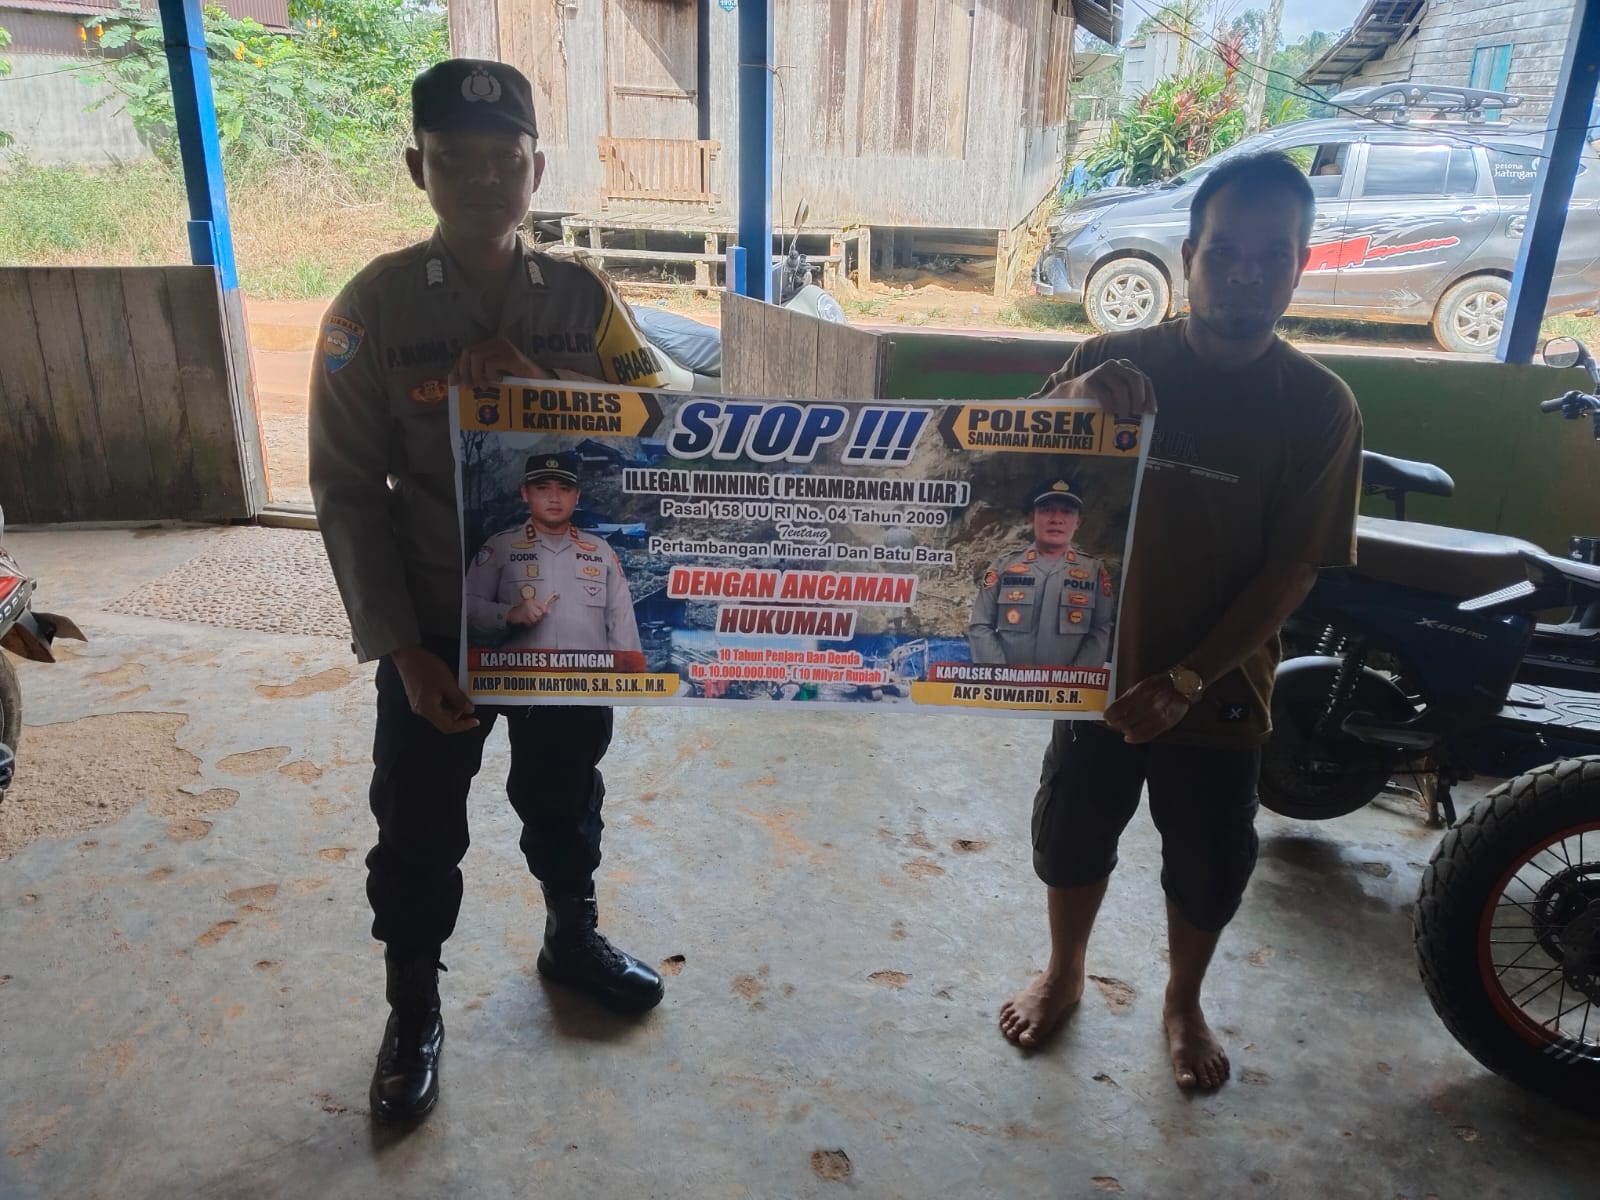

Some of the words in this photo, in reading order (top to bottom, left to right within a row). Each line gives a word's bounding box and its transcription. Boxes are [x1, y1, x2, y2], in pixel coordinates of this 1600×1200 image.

[1494, 162, 1524, 170] pesona
[532, 333, 592, 354] POLRI
[522, 388, 621, 414] POLRES
[522, 413, 622, 432] KATINGAN
[671, 401, 846, 458] STOP
[847, 408, 929, 461] !!!
[967, 408, 1096, 436] POLSEK
[967, 433, 1030, 449] SANAMAN
[1031, 434, 1093, 450] MANTIKEI
[625, 471, 689, 493] ILLEGAL
[692, 472, 770, 496] MINNING
[773, 477, 780, 497] (
[785, 477, 915, 502] PENAMBANGAN
[918, 482, 957, 505] LIAR
[961, 485, 968, 505] )
[663, 502, 708, 517] Pasal
[712, 504, 740, 518] 158
[745, 505, 769, 519] UU
[775, 506, 792, 520] RI
[796, 507, 823, 521] No.
[828, 508, 847, 522] 04
[852, 509, 901, 523] Tahun
[906, 510, 945, 525] 2009
[778, 524, 829, 542] Tentang
[510, 553, 538, 562] DODIK
[651, 539, 768, 558] Pertambangan
[773, 542, 833, 559] Mineral
[837, 545, 868, 559] Dan
[873, 546, 912, 561] Batu
[916, 548, 953, 562] Bara
[670, 569, 778, 599] DENGAN
[780, 573, 915, 603] ANCAMAN
[1063, 579, 1095, 591] POLRI
[719, 608, 853, 637] HUKUMAN
[480, 652, 547, 668] KAPOLRES
[550, 652, 614, 668] KATINGAN
[719, 648, 731, 662] 10
[733, 649, 763, 663] Tahun
[765, 650, 804, 666] Penjara
[806, 651, 826, 665] Dan
[827, 652, 860, 666] Denda
[691, 665, 706, 679] Rp.
[800, 667, 811, 681] 10
[812, 668, 843, 683] Milyar
[845, 669, 881, 684] Rupiah
[936, 666, 993, 681] KAPOLSEK
[994, 668, 1049, 683] SANAMAN
[1051, 671, 1106, 686] MANTIKEI
[472, 676, 502, 691] AKBP
[503, 677, 536, 692] DODIK
[538, 677, 590, 693] HARTONO,
[645, 678, 667, 692] M.H.
[953, 686, 981, 700] AKP
[983, 687, 1053, 705] SUWARDI,
[1056, 690, 1082, 704] S.H.
